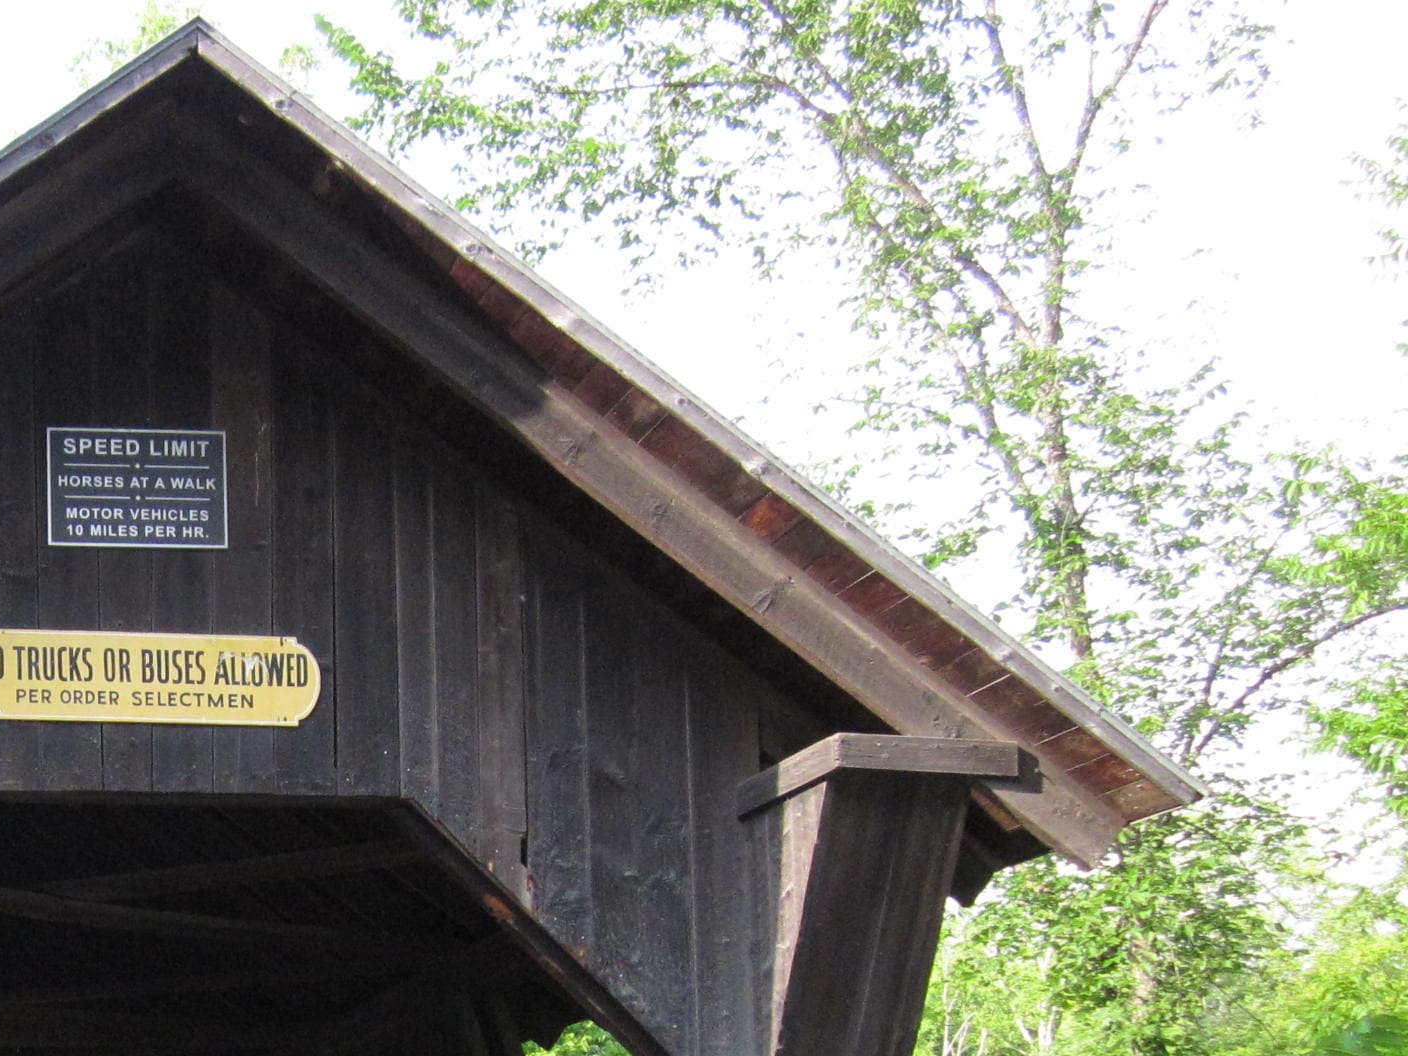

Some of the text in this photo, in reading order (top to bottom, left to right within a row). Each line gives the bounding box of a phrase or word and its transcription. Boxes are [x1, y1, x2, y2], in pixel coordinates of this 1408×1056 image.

[63, 438, 210, 457] SPEED LIMIT
[58, 475, 216, 490] HORSES AT A WALK
[66, 507, 209, 521] MOTOR VEHICLES
[66, 524, 209, 538] 10 MILES PER HR.
[13, 646, 93, 682] TRUCKS
[104, 647, 132, 683] OR
[142, 649, 206, 685] BUSES
[214, 651, 308, 688] ALLOWED
[15, 689, 254, 709] PER ORDER SELECTMEN
